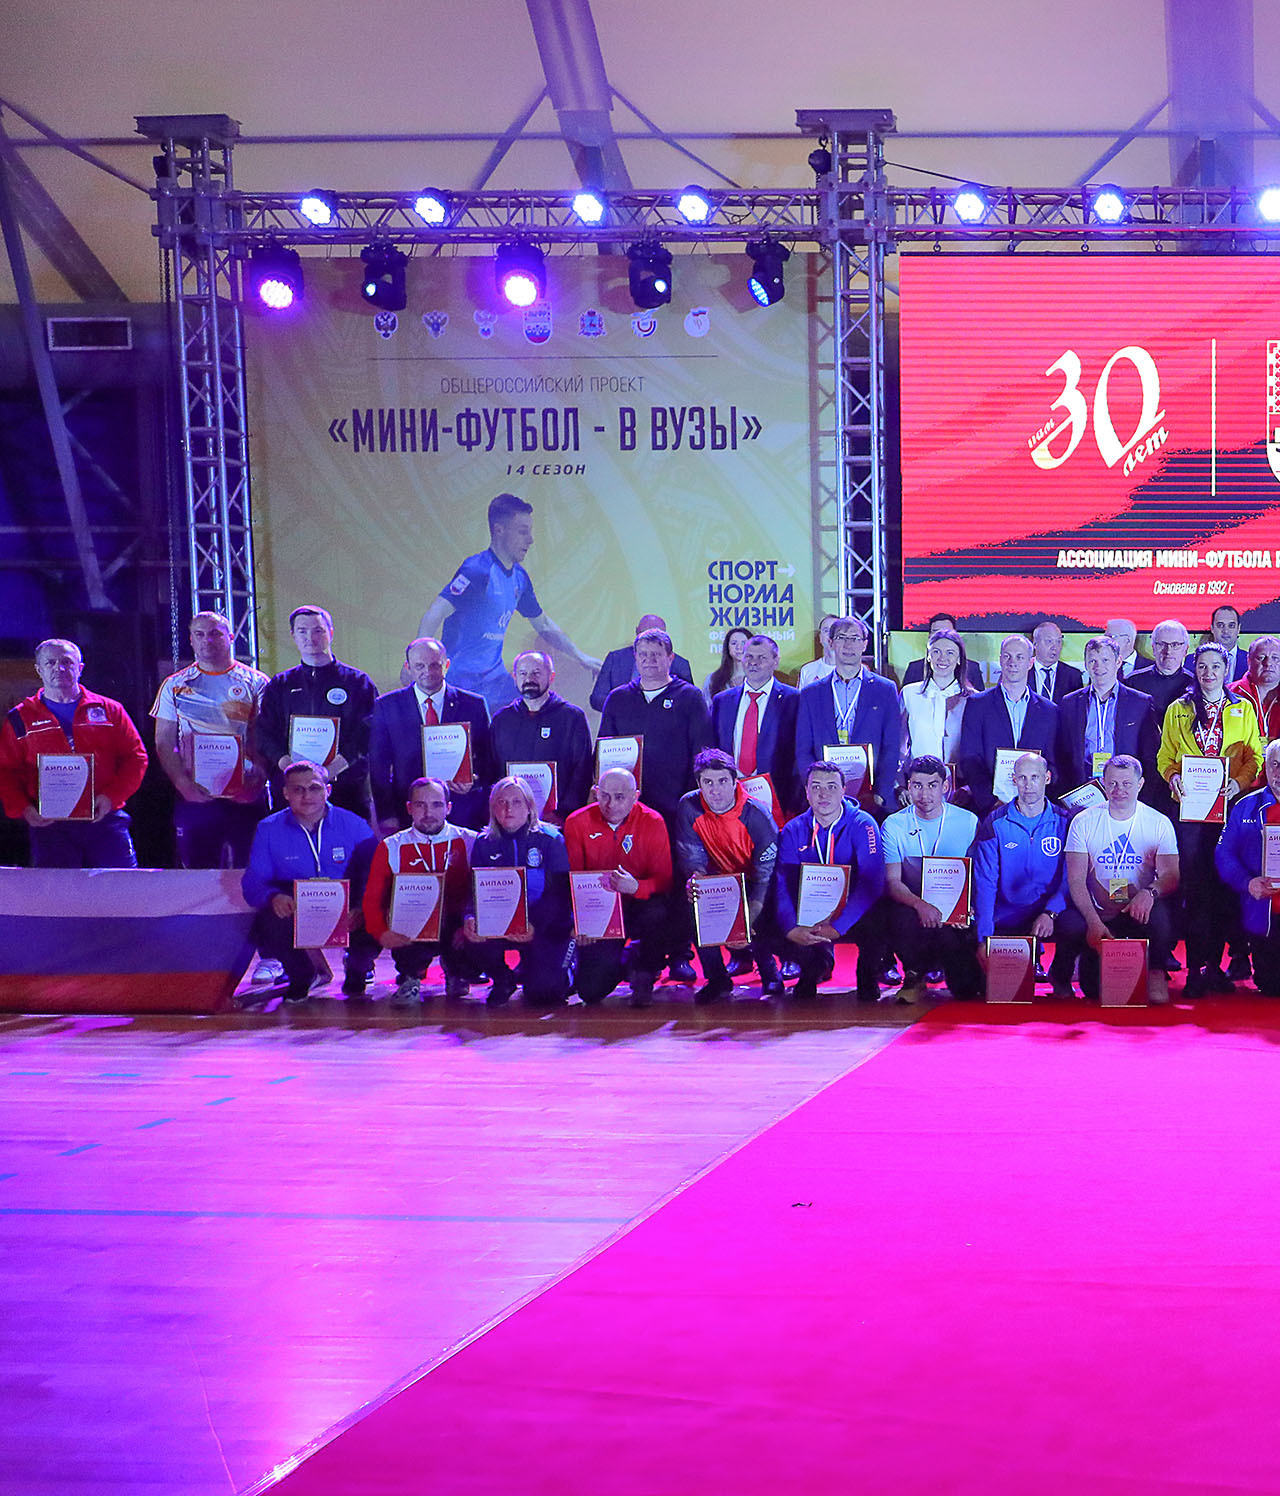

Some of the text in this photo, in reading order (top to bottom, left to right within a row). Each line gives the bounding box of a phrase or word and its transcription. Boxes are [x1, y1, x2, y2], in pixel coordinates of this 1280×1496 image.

[440, 374, 645, 394] ОБЩЕРОССИЙСКИЙ ПРОЕКТ
[1030, 345, 1166, 470] 30
[620, 407, 637, 451] В
[1123, 426, 1169, 477] лет
[506, 464, 586, 476] 14 СЕЗОН
[707, 560, 778, 581] СПОРТ
[1057, 550, 1153, 570] АССОЦИАЦИЯ
[1156, 550, 1272, 569] МИНИ-ФУТБОЛА
[709, 583, 794, 604] НОРМА
[1153, 580, 1197, 595] Основана
[1199, 583, 1206, 595] в
[1207, 580, 1227, 595] 1992
[709, 606, 794, 627] ЖИЗНИ
[1070, 791, 1095, 807] ДИПЛОМ
